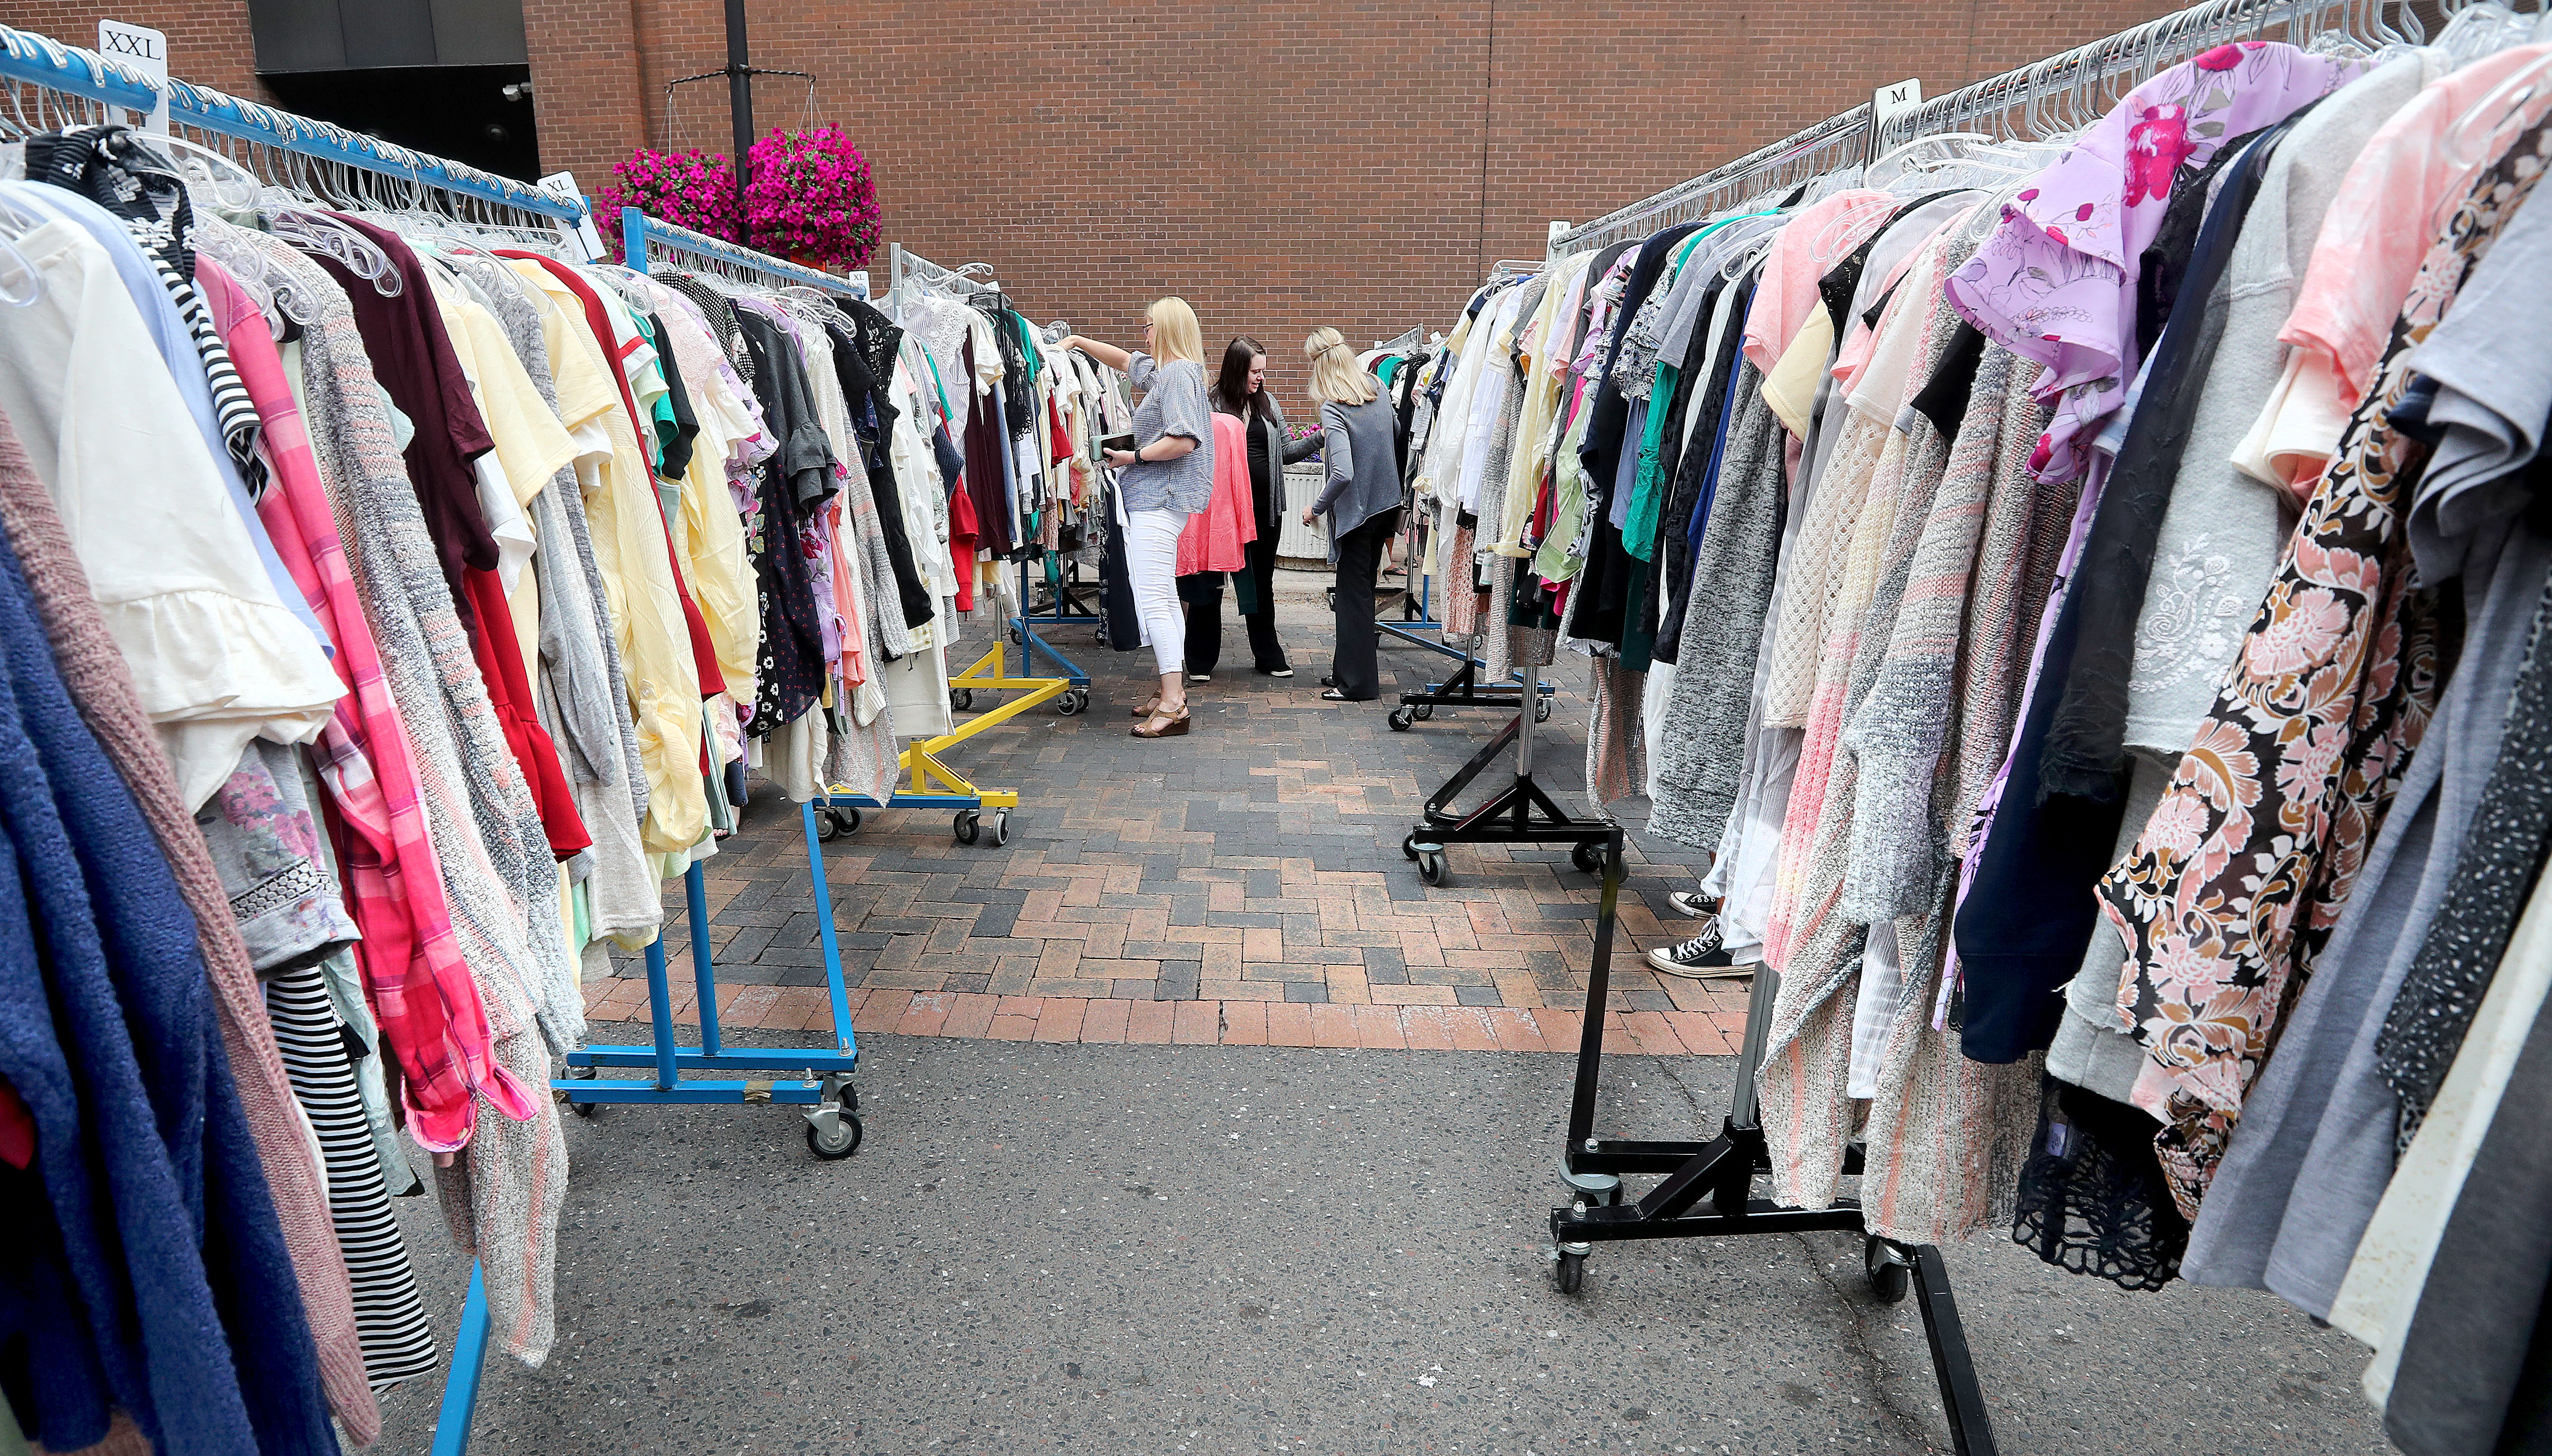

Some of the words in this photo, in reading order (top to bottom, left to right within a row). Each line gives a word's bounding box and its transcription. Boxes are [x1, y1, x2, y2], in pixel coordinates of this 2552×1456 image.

[104, 30, 161, 60] XXL
[1890, 86, 1908, 105] M
[546, 179, 570, 192] XL
